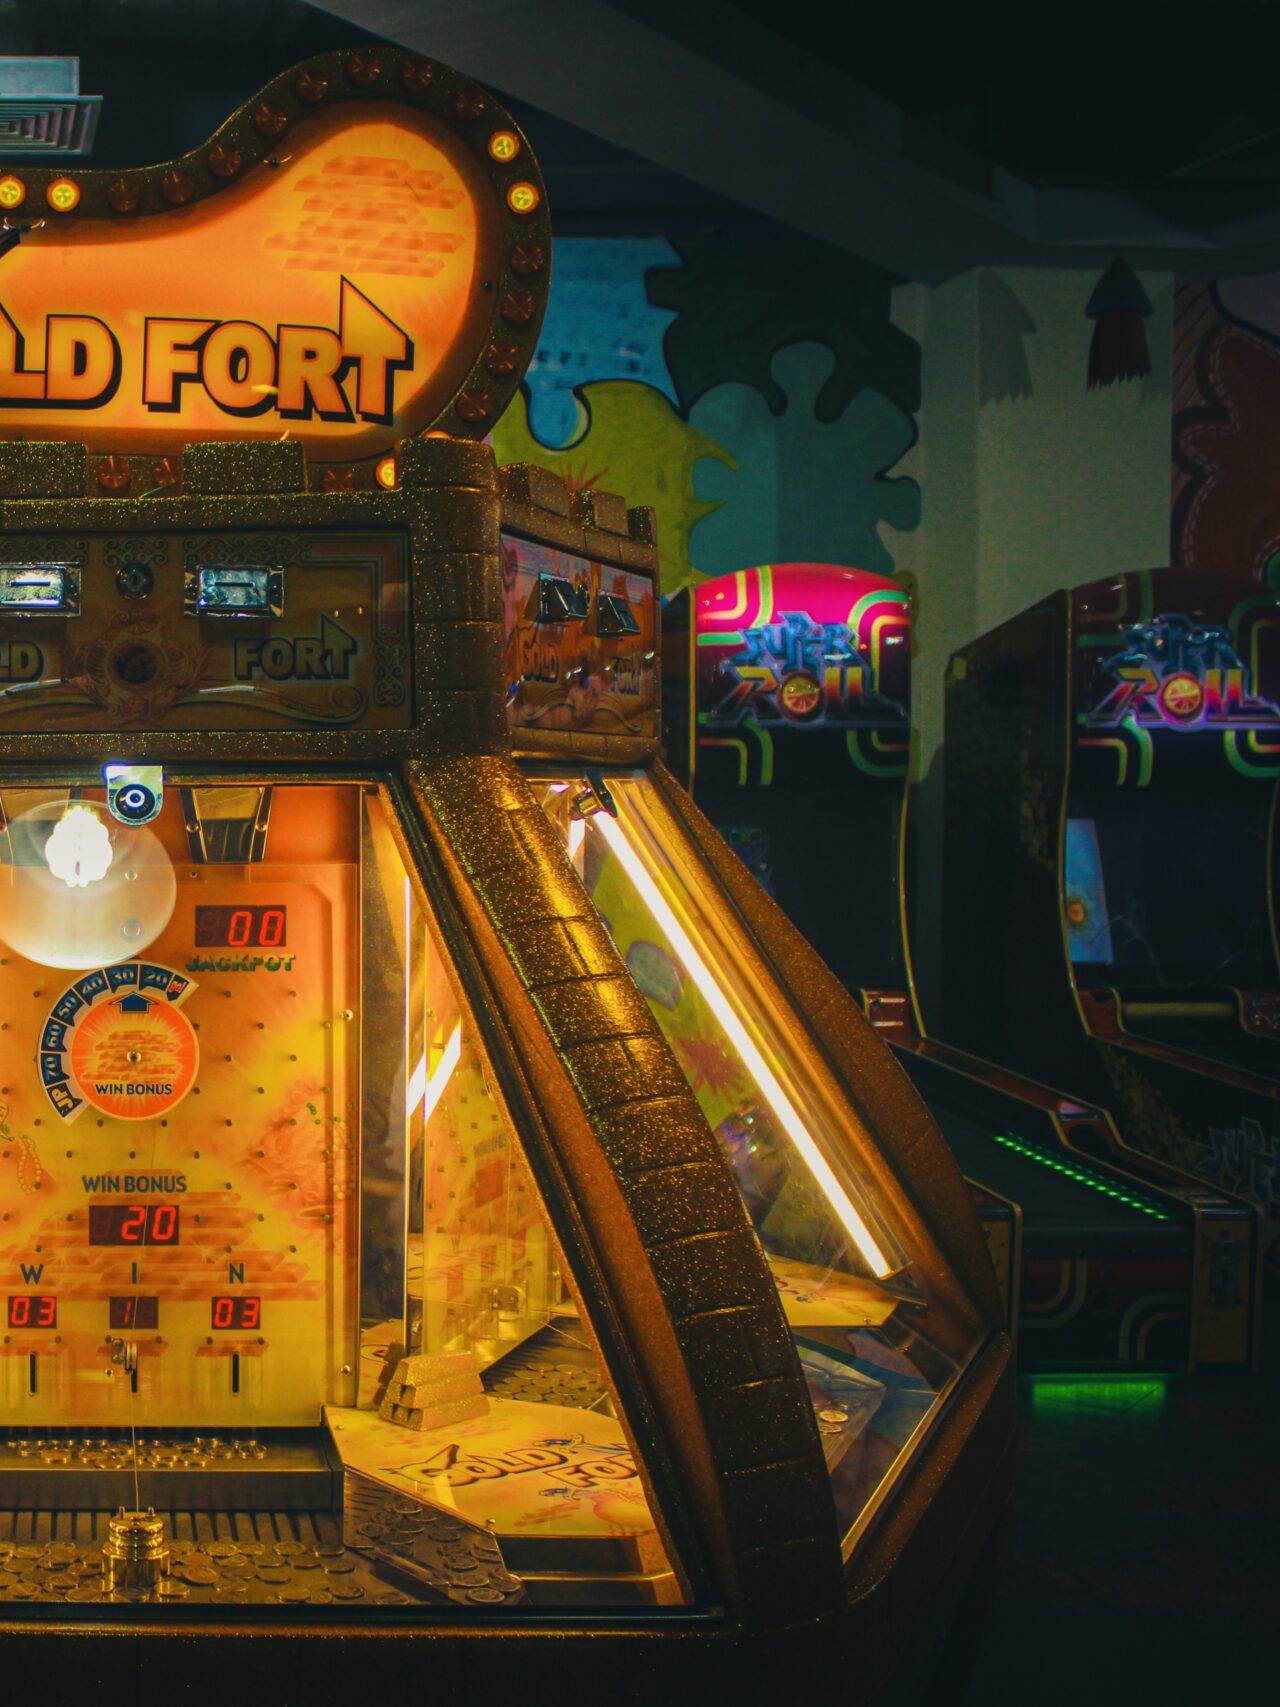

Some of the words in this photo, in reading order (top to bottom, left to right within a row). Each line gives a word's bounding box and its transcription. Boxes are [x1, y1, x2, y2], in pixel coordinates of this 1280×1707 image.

[142, 274, 414, 426] FORT
[234, 612, 358, 682] FORT
[726, 611, 865, 675] SUPER
[710, 667, 910, 727] ROLL
[227, 911, 284, 945] 00
[185, 954, 296, 972] JACKPOT
[82, 975, 103, 995] 40
[111, 968, 134, 984] 30
[145, 970, 168, 985] 20
[58, 996, 76, 1019] 50
[47, 1024, 63, 1048] 60
[45, 1057, 59, 1081] 70
[51, 1087, 74, 1110] JP
[96, 1084, 123, 1095] WIN
[126, 1084, 173, 1095] BONUS
[81, 1175, 120, 1193] WIN
[124, 1175, 187, 1193] BONUS
[121, 1205, 178, 1241] 20
[20, 1263, 44, 1285] W
[131, 1262, 138, 1284] I
[229, 1263, 245, 1285] N
[11, 1297, 57, 1326] 03
[123, 1299, 132, 1324] 1
[213, 1298, 260, 1328] 03
[376, 1443, 569, 1488] GOLD
